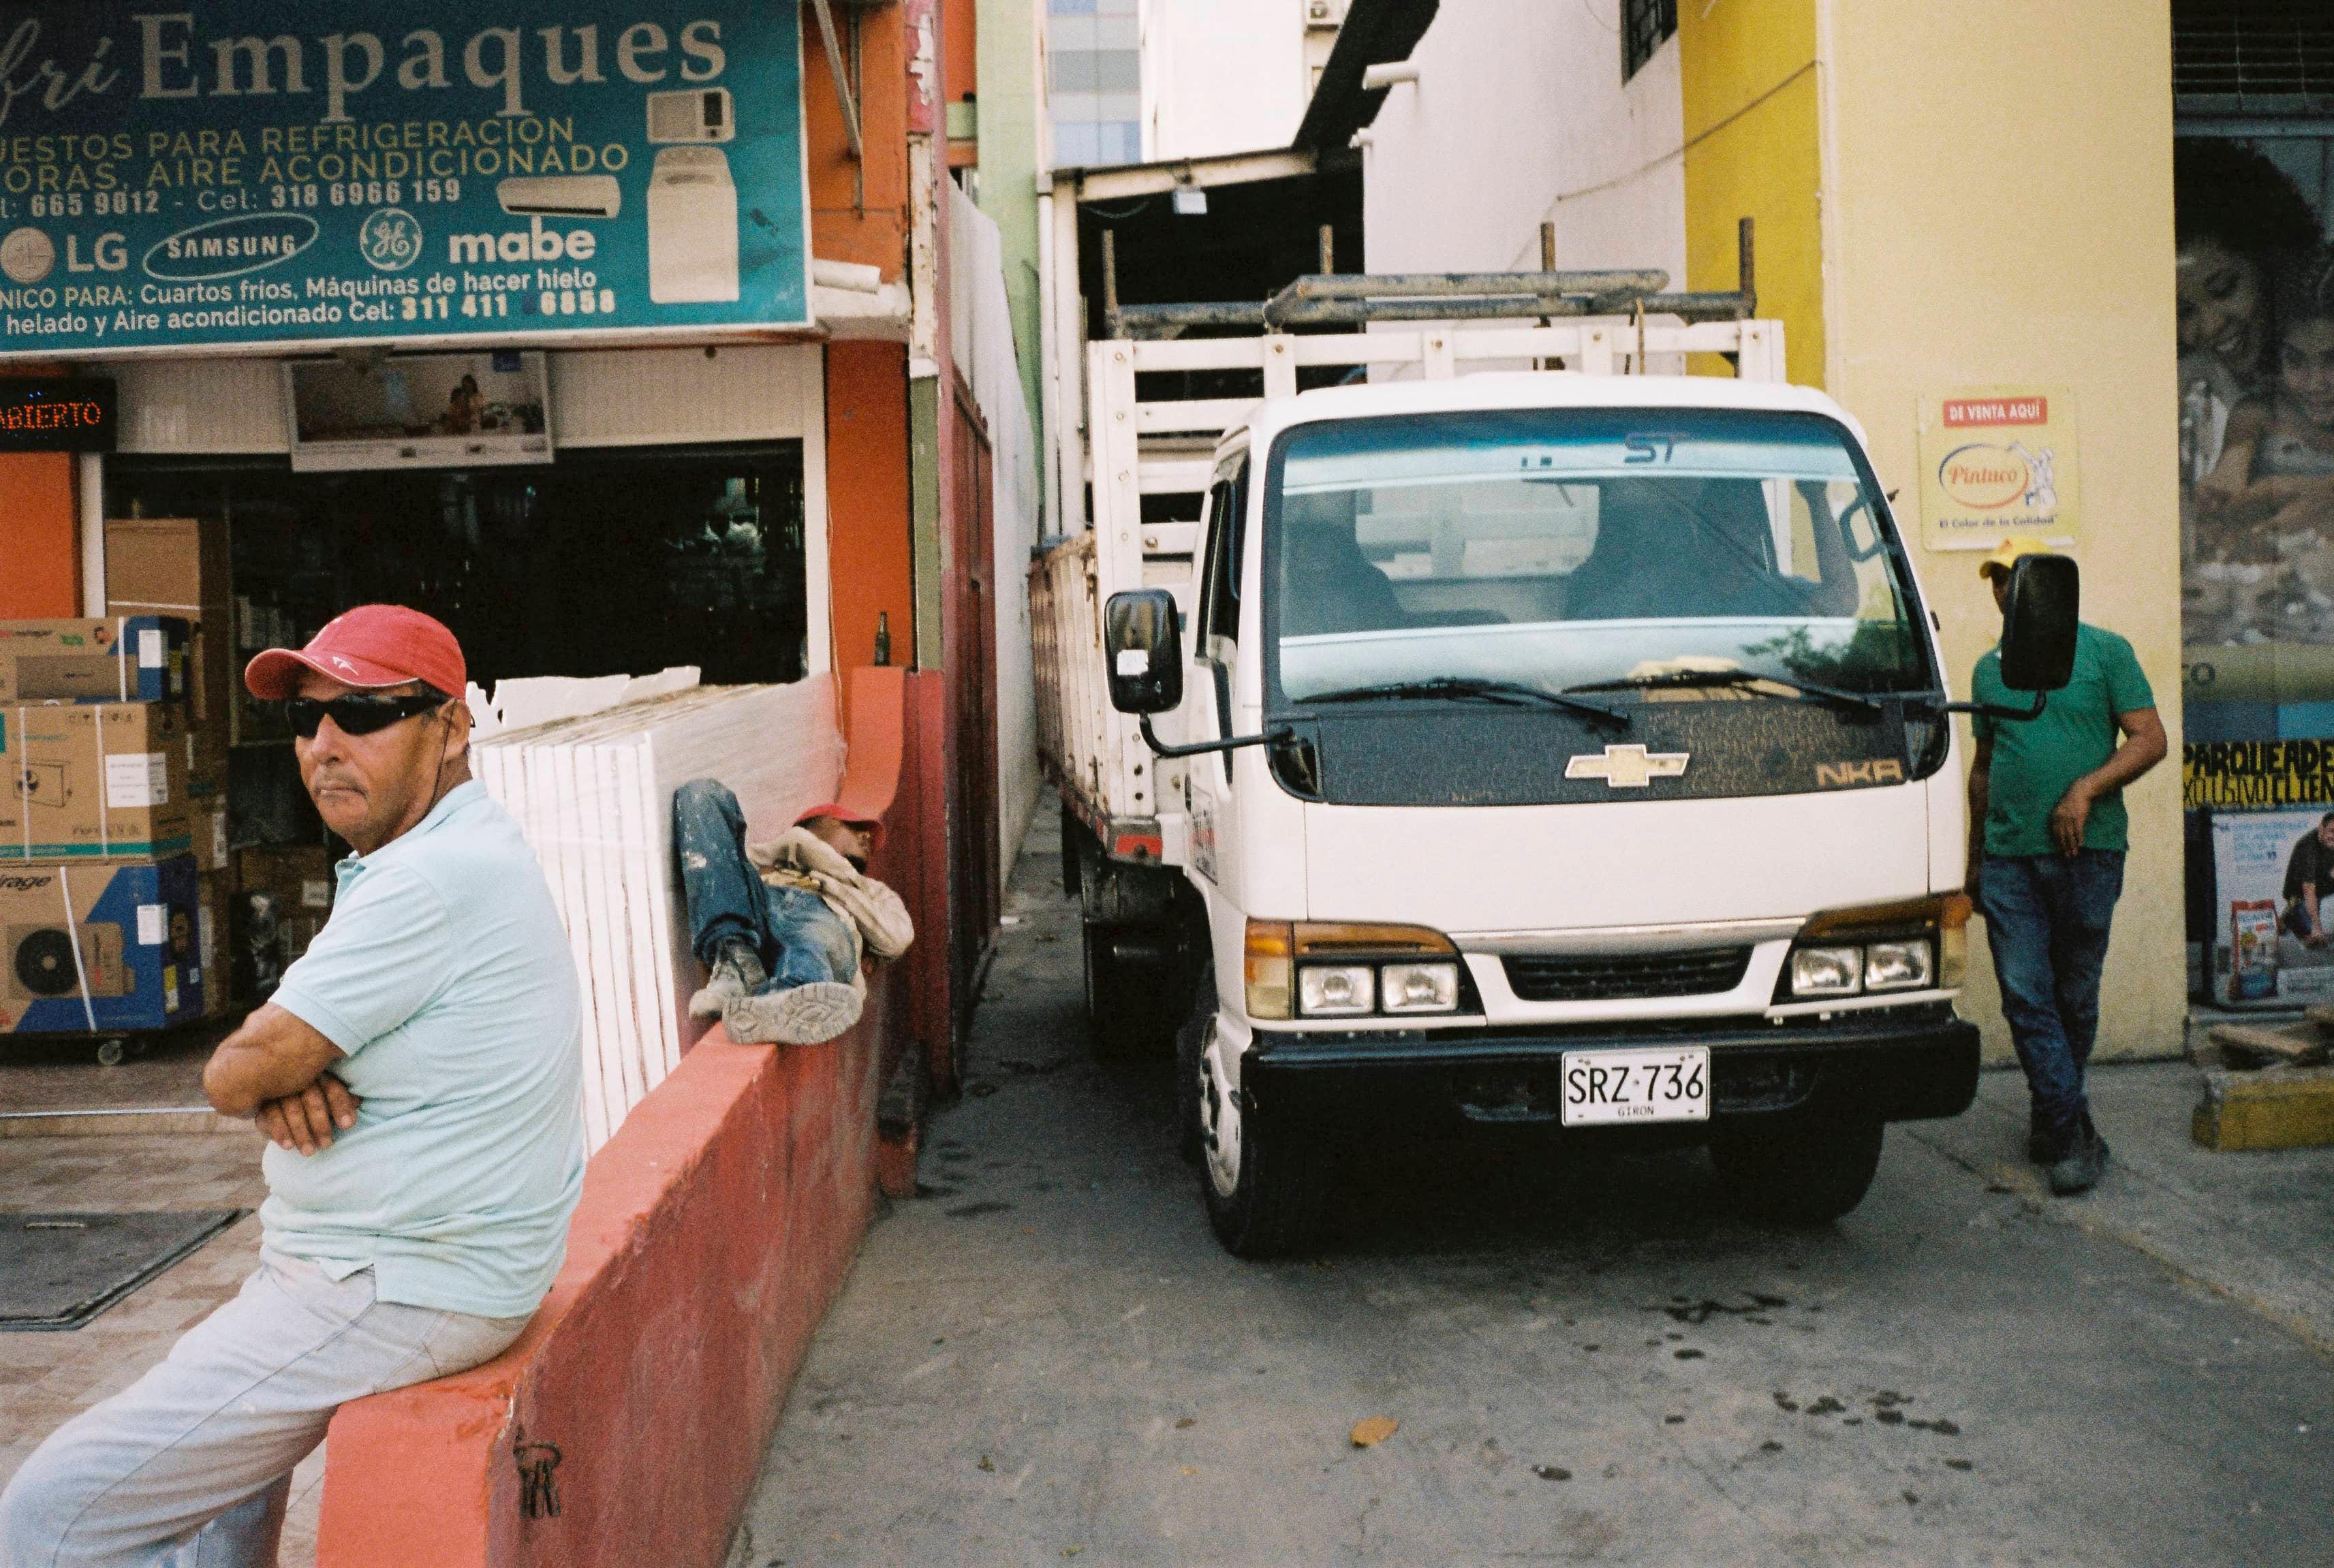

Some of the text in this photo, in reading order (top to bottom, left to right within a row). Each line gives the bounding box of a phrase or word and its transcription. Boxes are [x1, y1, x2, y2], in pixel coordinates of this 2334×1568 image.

[132, 12, 726, 123] Empaques
[149, 129, 247, 157] PARA
[147, 157, 241, 187] AIRE
[259, 143, 628, 183] ACONDICIONADO
[31, 191, 83, 217] 665
[95, 190, 159, 215] 9012
[198, 187, 258, 212] Cel:
[271, 183, 318, 208] 318
[330, 180, 402, 206] 6966
[412, 178, 460, 203] 159
[67, 232, 129, 272] LG
[168, 235, 296, 259] SAMSUNG
[449, 216, 596, 264] mabe
[65, 284, 133, 307] PARA:
[141, 280, 232, 305] Cuartos
[306, 275, 419, 302] Máquinas
[426, 272, 456, 294] de
[464, 270, 531, 292] hacer
[538, 267, 597, 289] hielo
[7, 313, 88, 335] helado
[95, 315, 108, 337] y
[114, 309, 160, 332] Aire
[168, 302, 342, 329] acondicionado
[349, 299, 395, 322] Cel:
[401, 294, 449, 321] 311
[461, 293, 508, 318] 411
[1949, 405, 1964, 421] DE
[1967, 403, 2006, 420] VENTA
